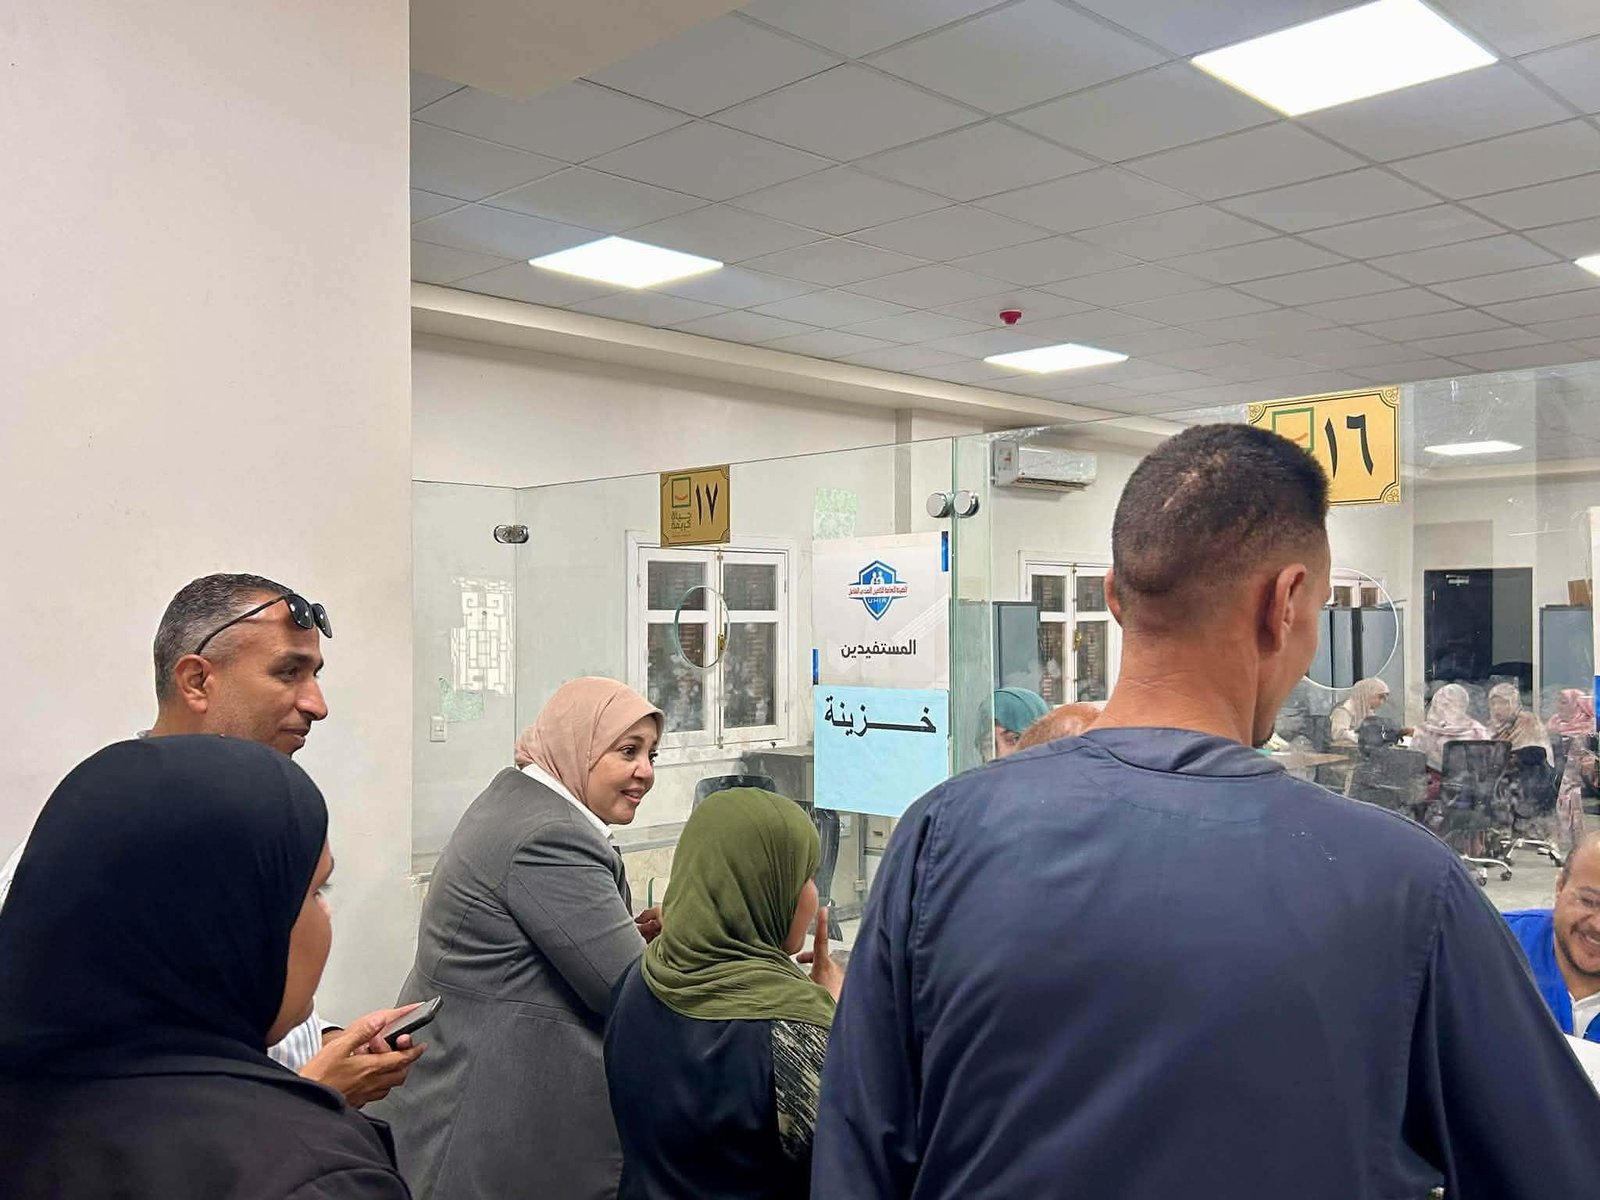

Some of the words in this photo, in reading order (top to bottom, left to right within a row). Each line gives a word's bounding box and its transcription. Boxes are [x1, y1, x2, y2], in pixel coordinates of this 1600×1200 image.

[1325, 414, 1373, 479] ١٦
[695, 482, 718, 525] ١٧
[841, 639, 917, 659] المستفيدين
